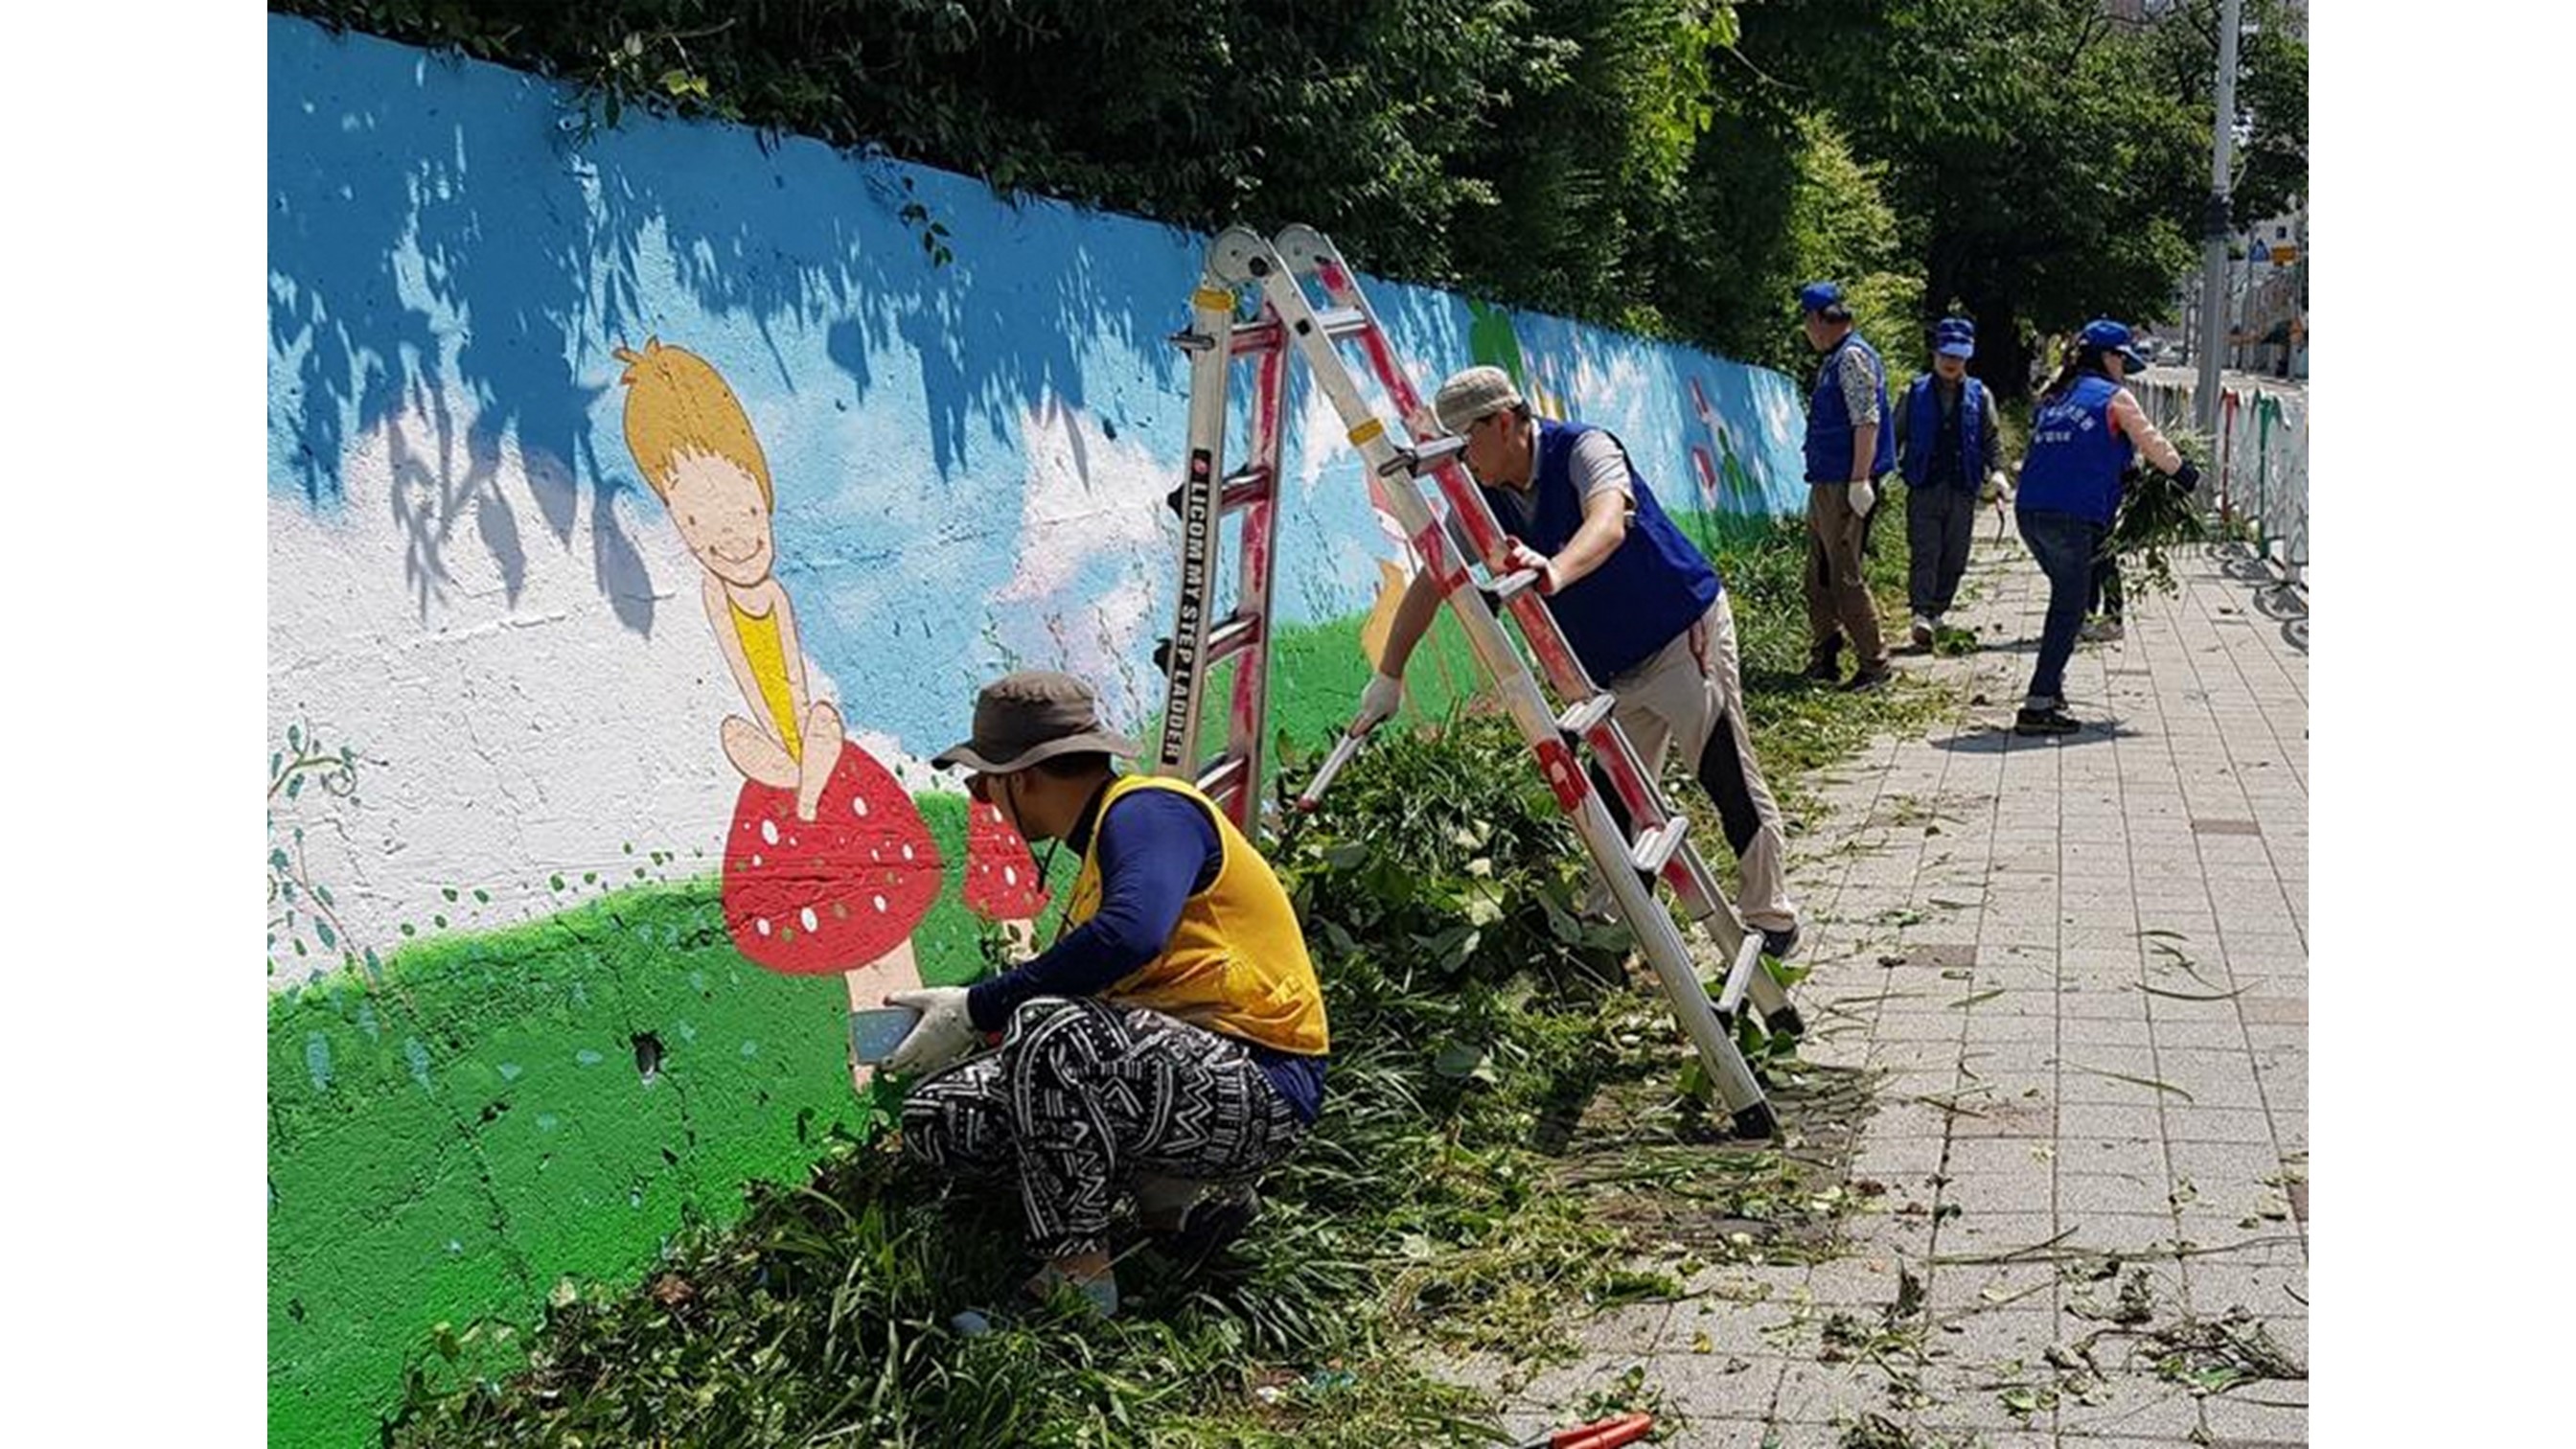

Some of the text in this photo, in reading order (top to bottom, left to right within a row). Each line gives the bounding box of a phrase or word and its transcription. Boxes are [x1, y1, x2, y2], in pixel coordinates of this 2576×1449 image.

[1164, 482, 1208, 757] LICOM MY STEP LADDER
